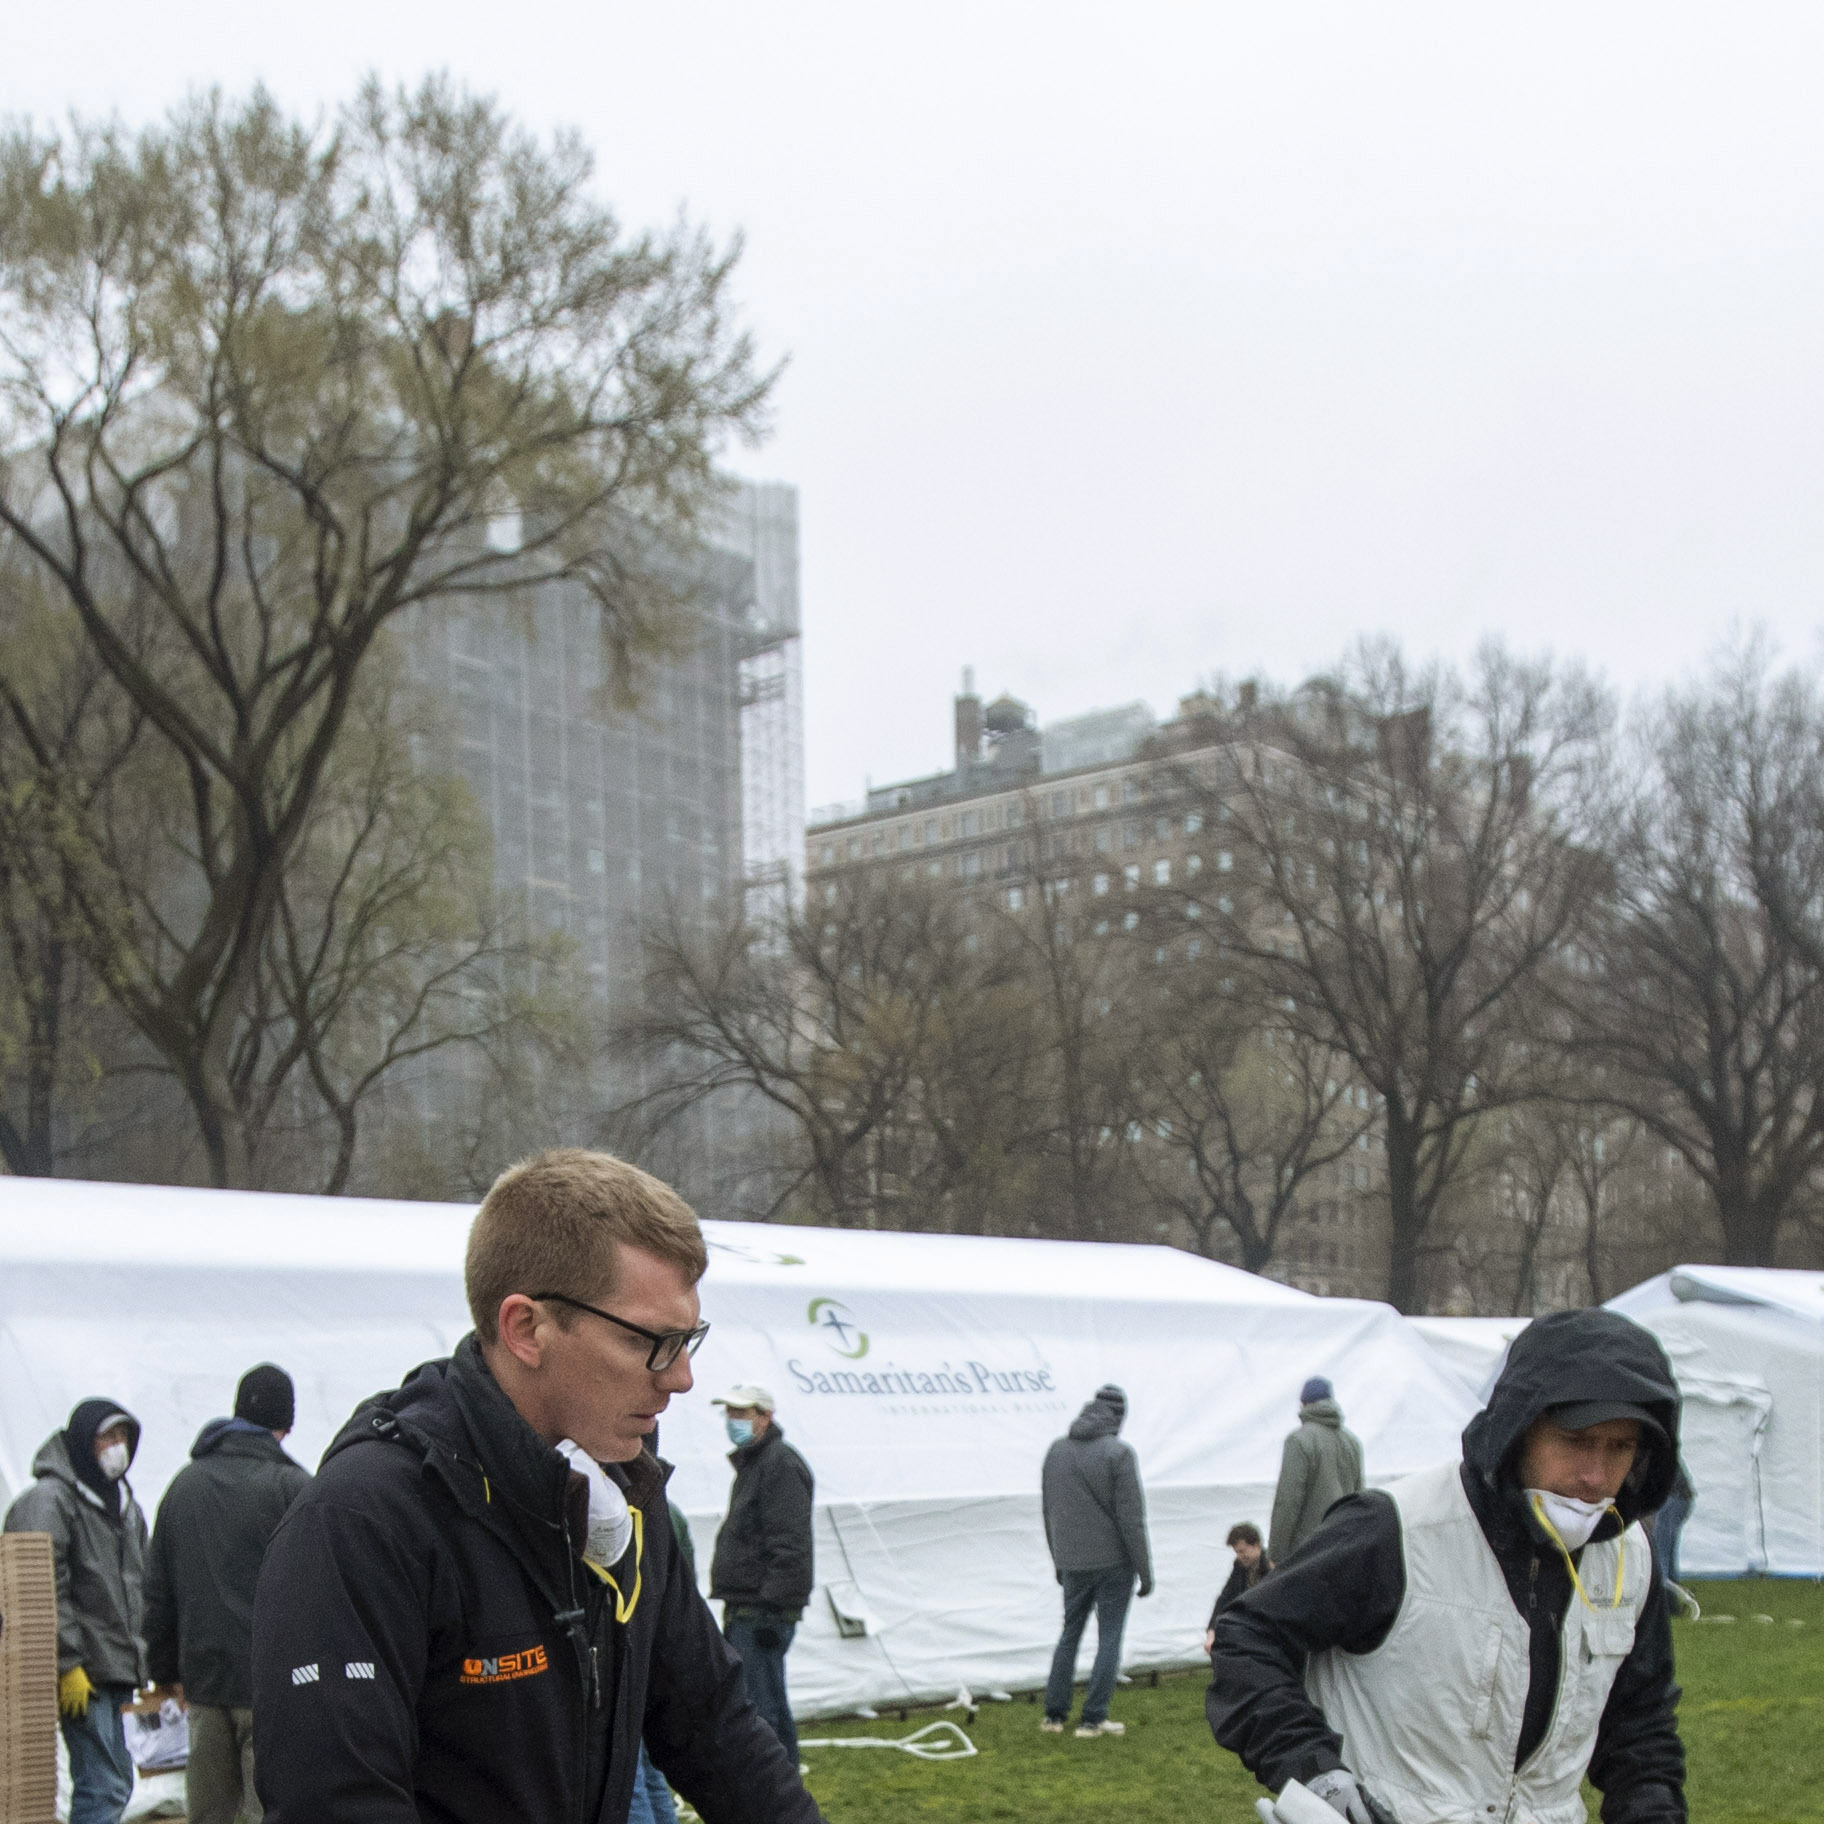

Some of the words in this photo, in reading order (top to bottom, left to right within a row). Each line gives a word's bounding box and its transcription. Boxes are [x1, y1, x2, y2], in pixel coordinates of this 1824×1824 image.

[787, 1358, 973, 1394] Samaritan's
[965, 1360, 1057, 1392] Purse
[463, 1644, 548, 1676] ONSITE
